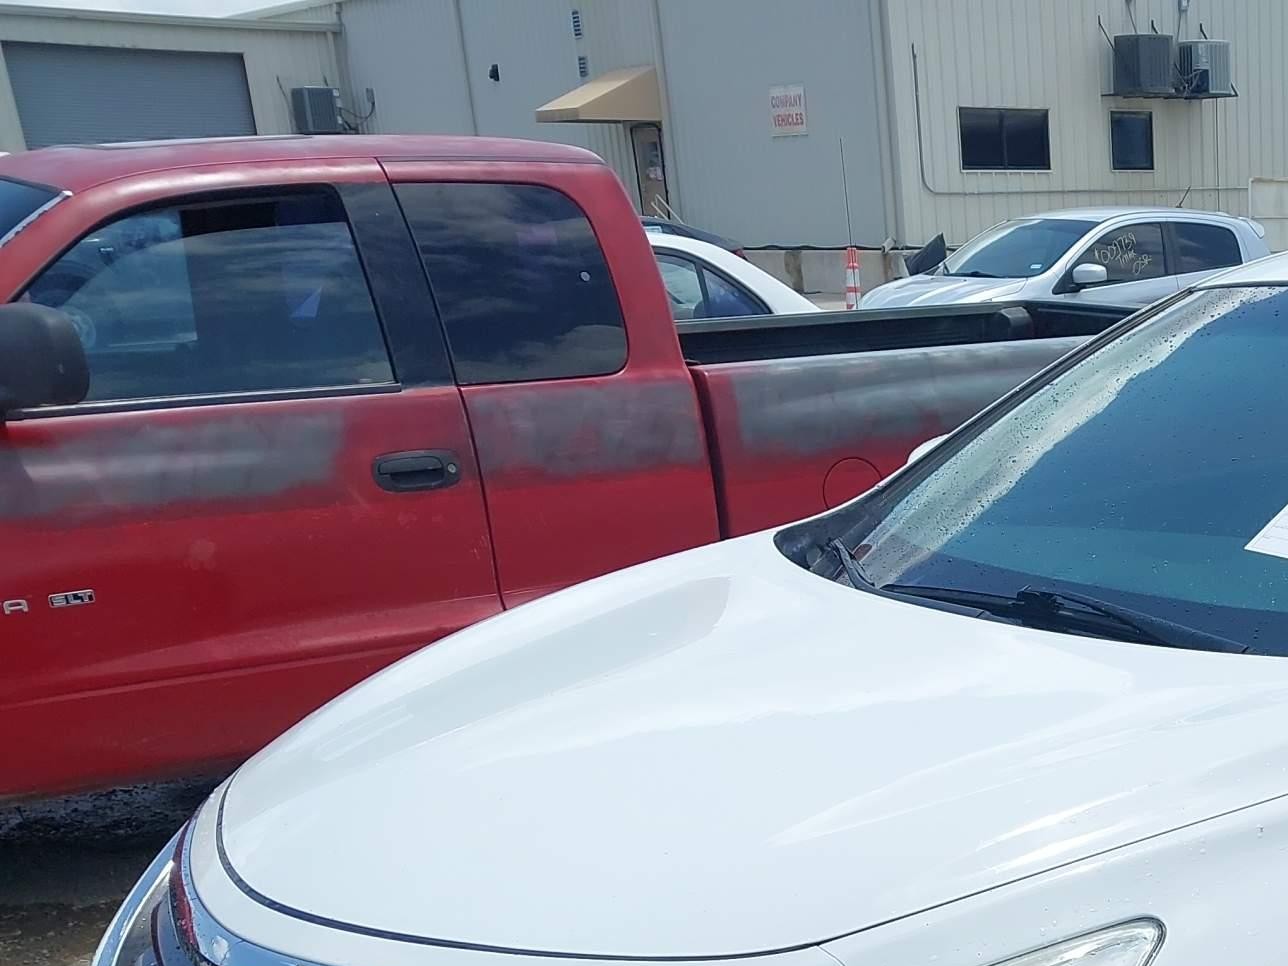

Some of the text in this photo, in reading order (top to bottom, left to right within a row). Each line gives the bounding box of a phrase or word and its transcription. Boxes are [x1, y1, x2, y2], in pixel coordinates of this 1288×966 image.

[770, 95, 802, 109] COMPANY
[773, 112, 804, 128] VEHICLES
[0, 591, 93, 615] A SLT
